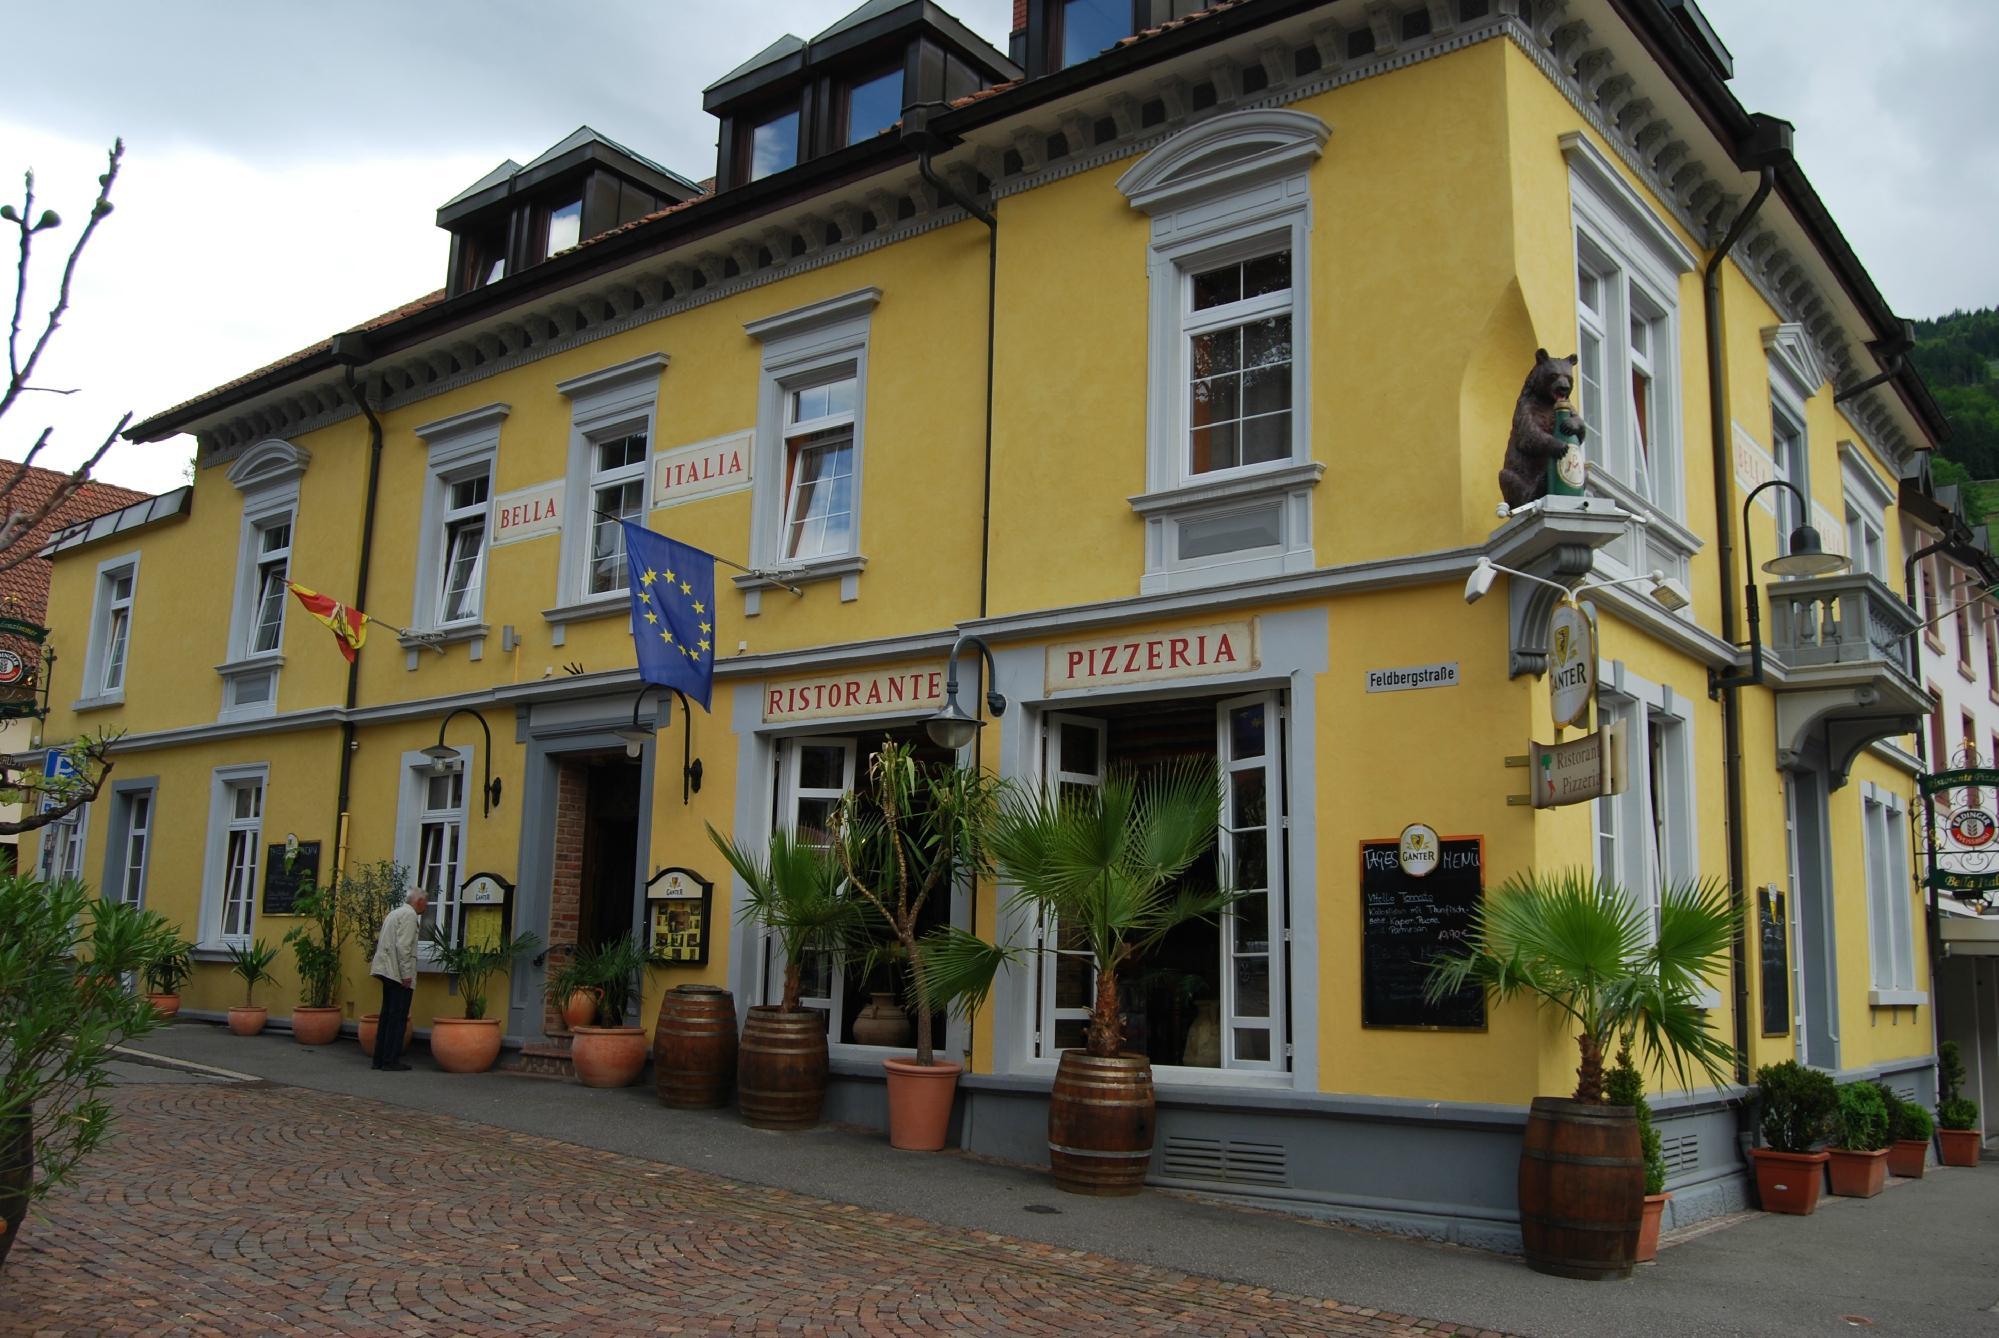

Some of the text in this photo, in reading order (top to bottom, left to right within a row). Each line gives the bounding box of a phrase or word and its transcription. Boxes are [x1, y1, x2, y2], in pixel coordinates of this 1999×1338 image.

[500, 450, 742, 529] BELLA ITALIA
[1067, 633, 1236, 679] PIZZERIA
[1370, 667, 1454, 687] Feldbergstraße
[768, 671, 942, 715] RISTORANTE
[1363, 848, 1399, 871] TAGES
[1402, 850, 1436, 863] GANTER
[1944, 875, 1974, 888] Bella
